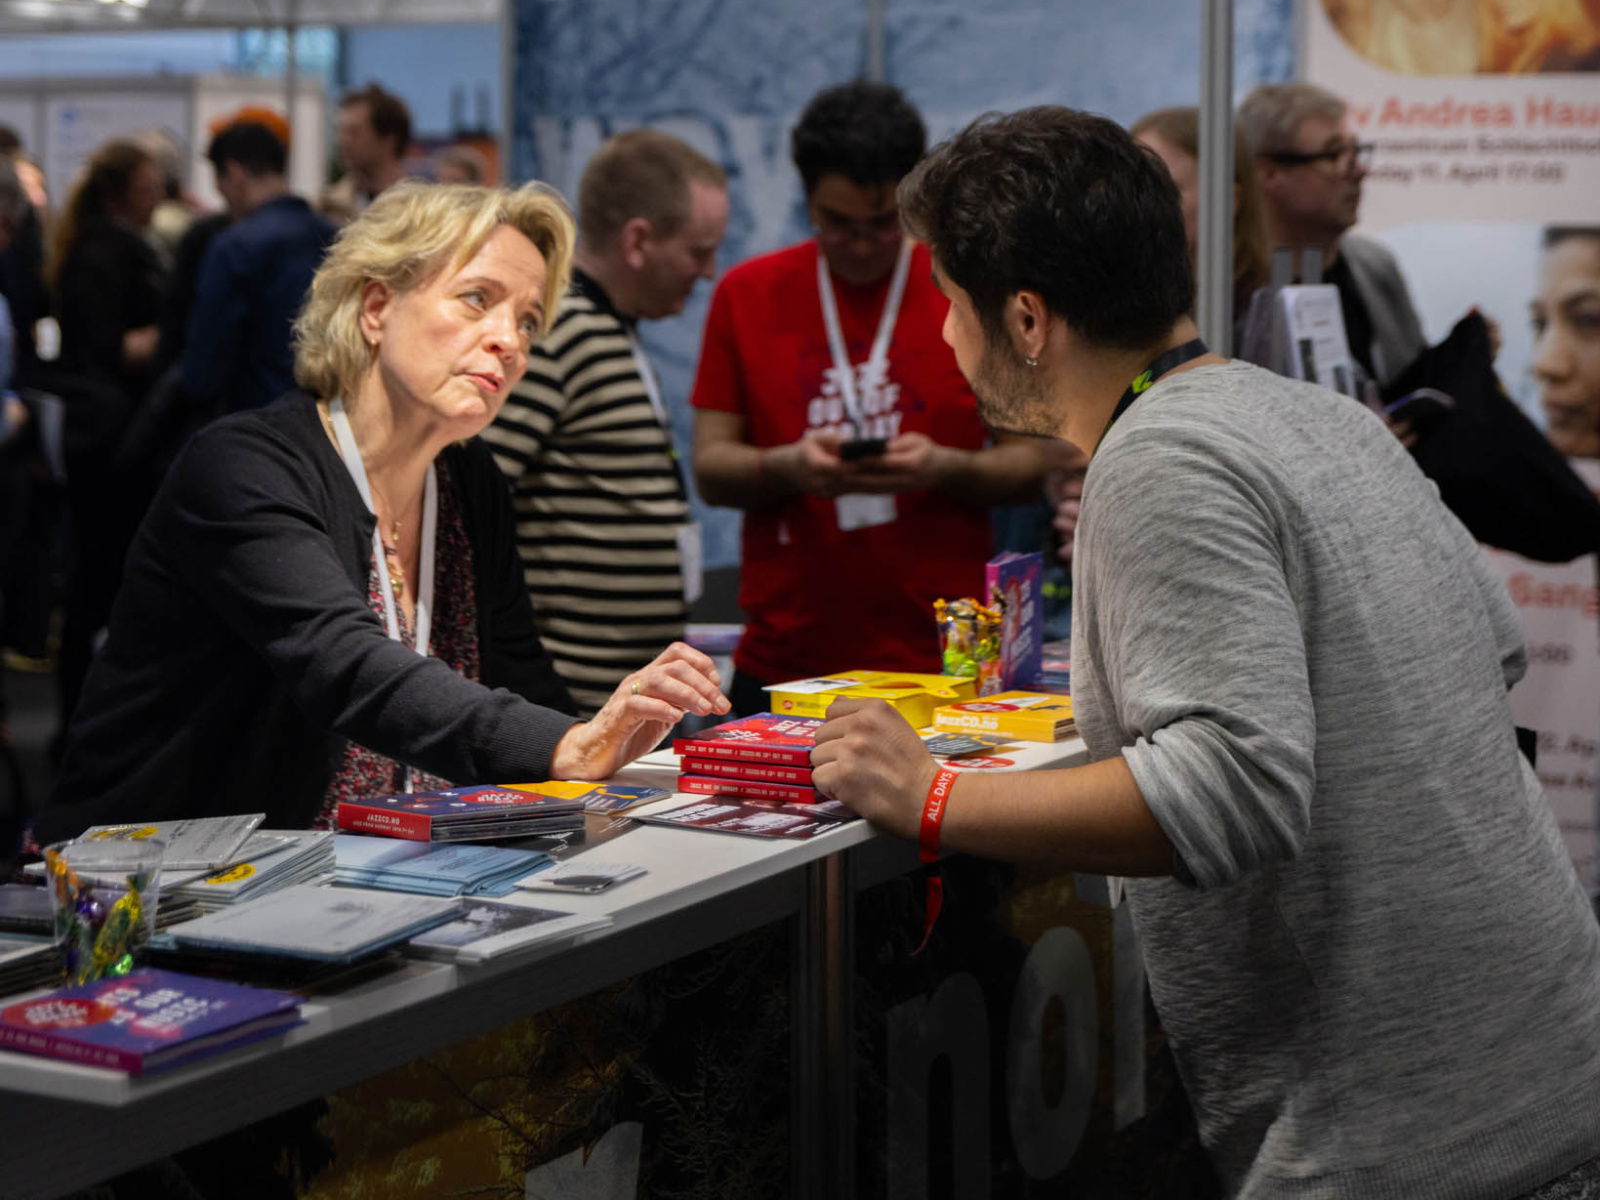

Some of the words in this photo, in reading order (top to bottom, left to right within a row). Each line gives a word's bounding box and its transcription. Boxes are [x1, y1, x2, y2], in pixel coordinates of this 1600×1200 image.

[1378, 95, 1514, 128] Andrea
[934, 771, 953, 797] DAYS
[927, 799, 942, 823] ALL
